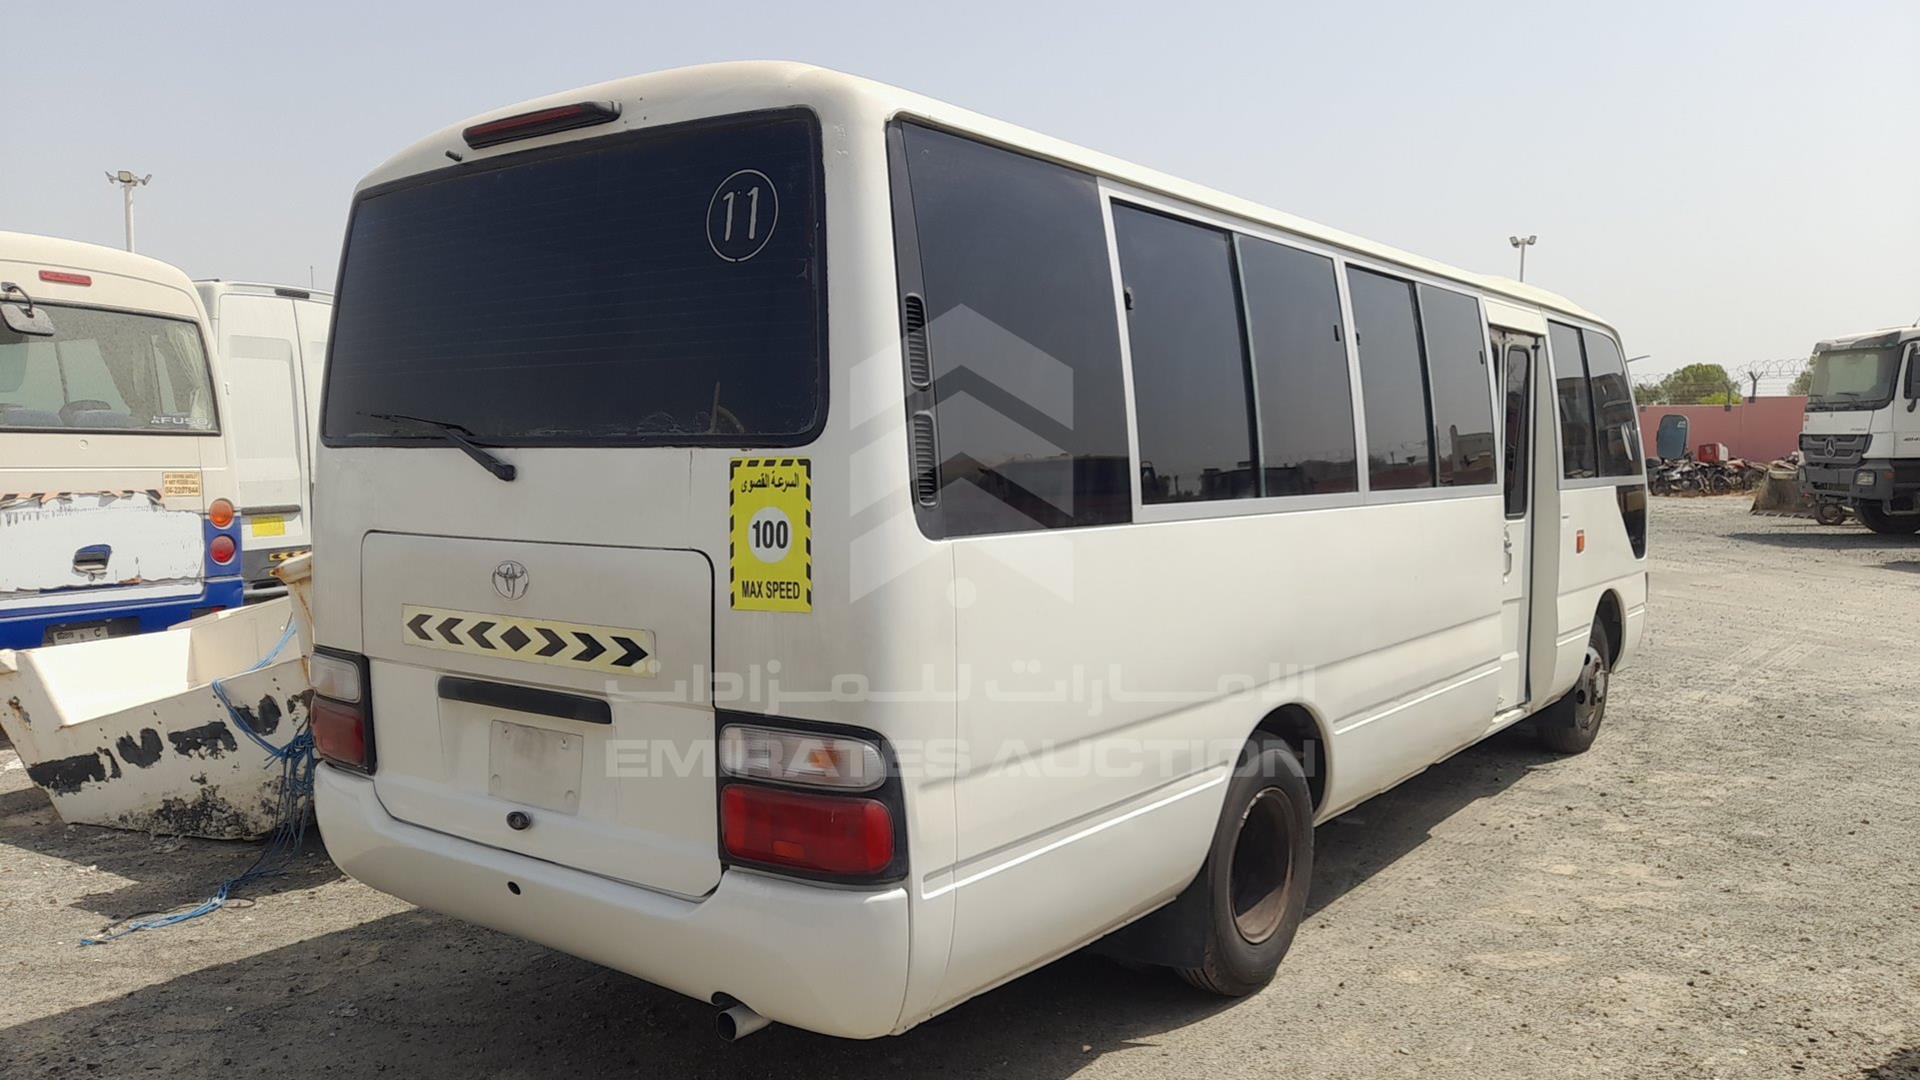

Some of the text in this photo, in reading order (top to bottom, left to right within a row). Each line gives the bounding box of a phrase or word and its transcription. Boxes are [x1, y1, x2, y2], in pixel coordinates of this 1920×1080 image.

[723, 187, 758, 241] 11
[161, 416, 208, 425] FUSO
[741, 470, 800, 493] السرعة القصوى
[752, 520, 788, 549] 100
[741, 581, 800, 599] MAX SPEED
